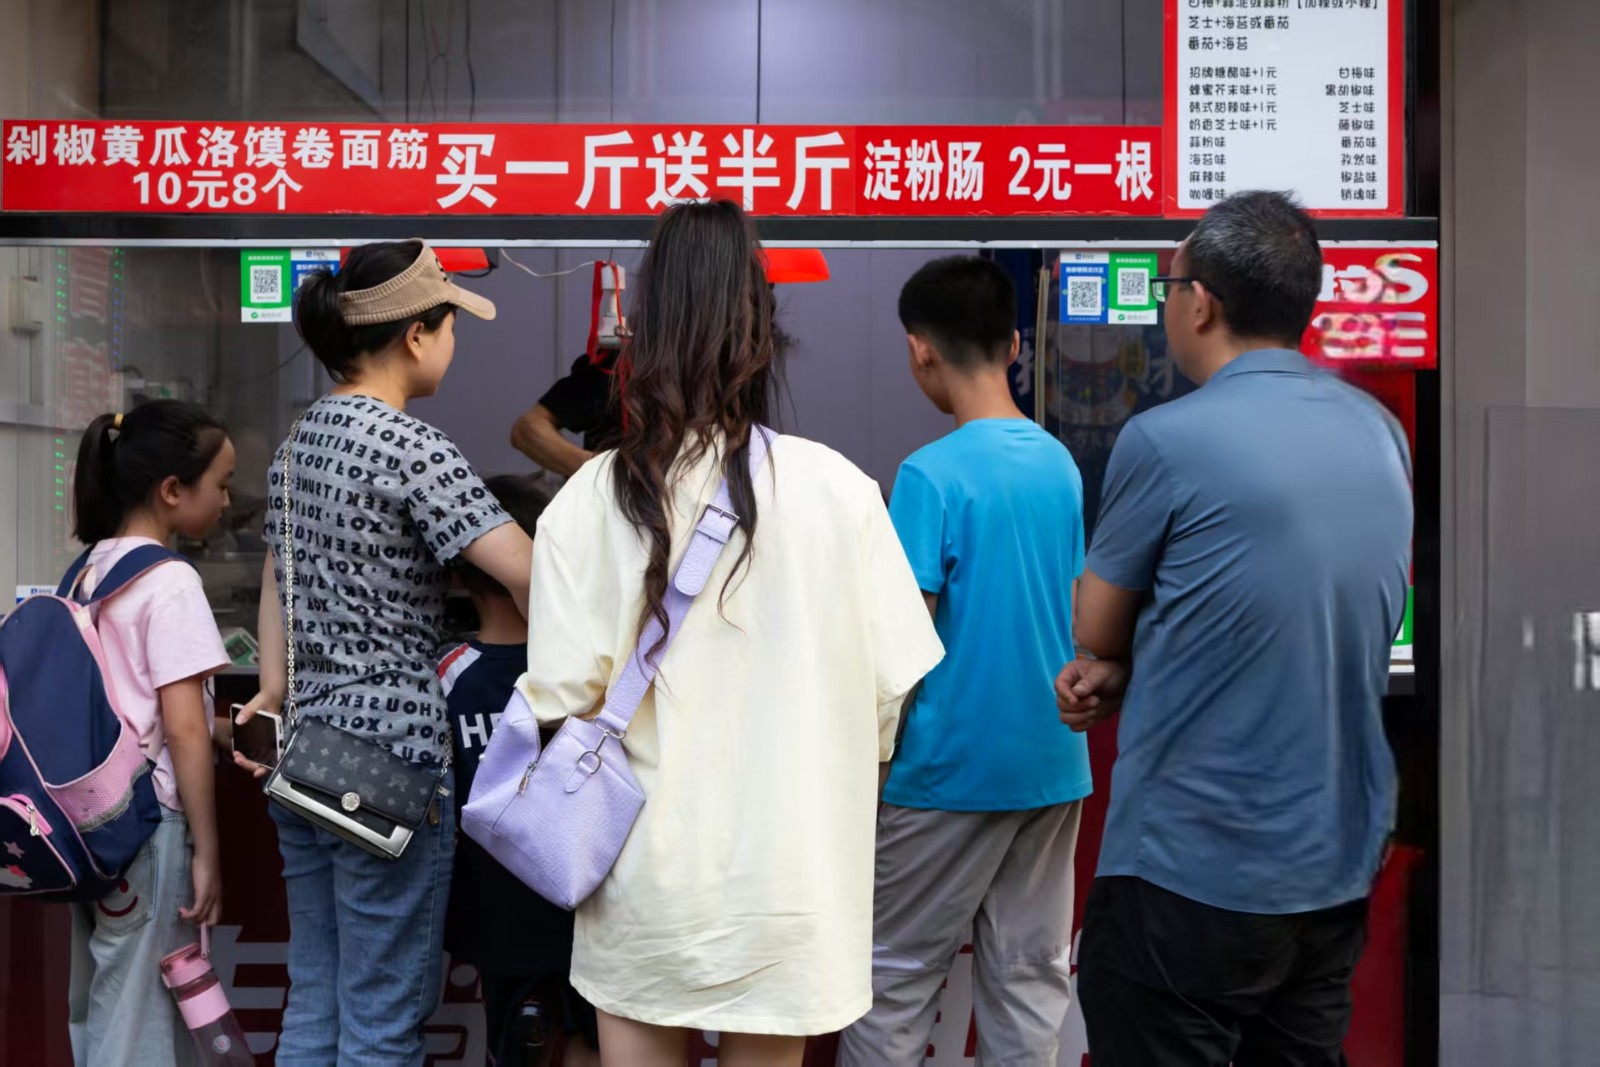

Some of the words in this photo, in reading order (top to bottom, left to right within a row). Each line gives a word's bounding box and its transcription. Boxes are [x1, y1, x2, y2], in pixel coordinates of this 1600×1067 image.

[1188, 16, 1290, 30] 芝士+海苔或番茄
[1188, 36, 1249, 50] 番茄+海苔
[1338, 101, 1375, 114] 芝士味
[6, 124, 429, 170] 剁椒黄瓜洛馍卷面筋
[1189, 136, 1226, 149] 蒜粉味
[1341, 136, 1377, 149] 番茄味
[1189, 153, 1226, 166] 海苔味
[436, 128, 850, 212] 买一斤送半斤
[863, 138, 984, 202] 淀粉肠
[1008, 139, 1154, 202] 2元一根
[1189, 171, 1226, 183] 麻辣味
[133, 169, 303, 211] 10元8个
